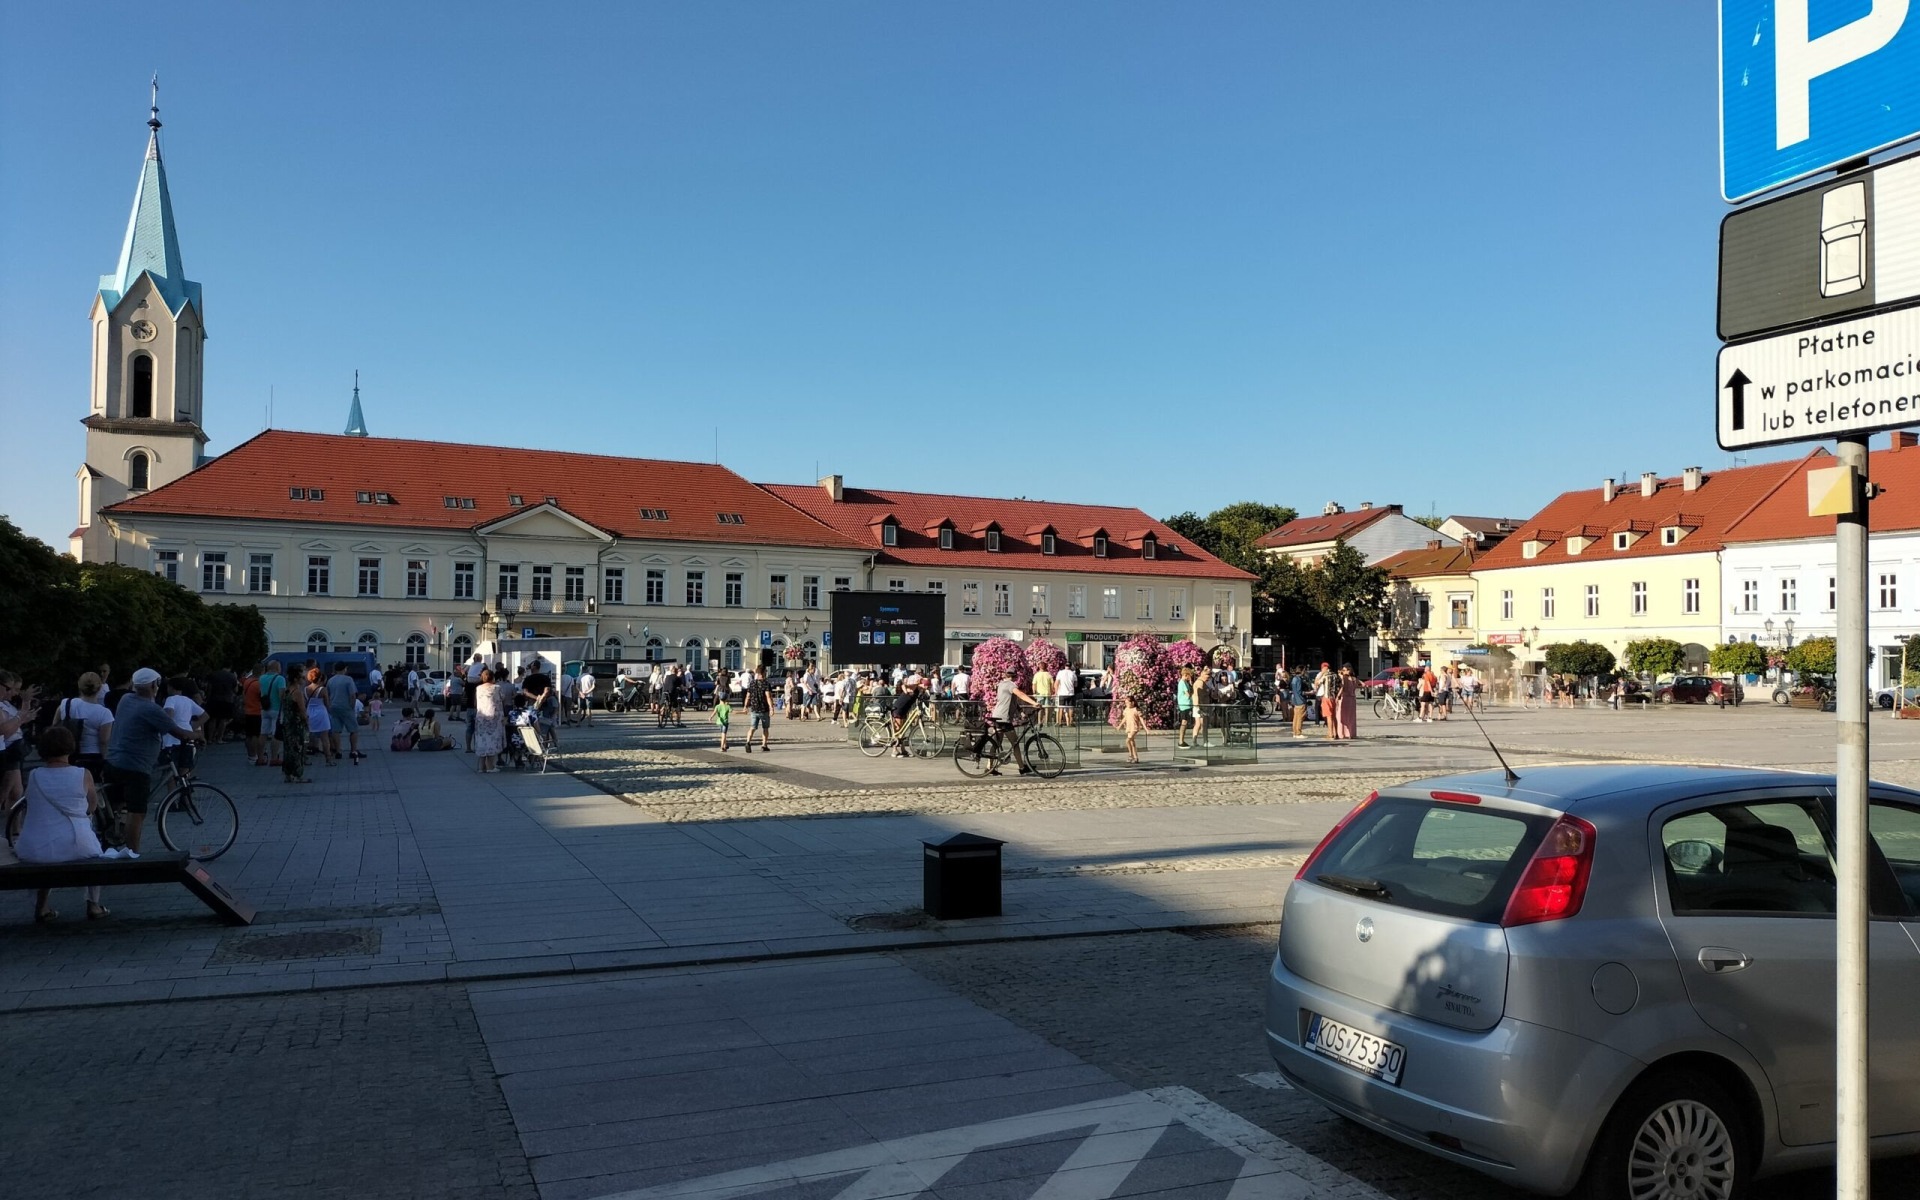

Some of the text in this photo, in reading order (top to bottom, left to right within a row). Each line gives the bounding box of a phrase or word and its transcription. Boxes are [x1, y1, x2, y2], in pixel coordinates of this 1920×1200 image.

[1798, 330, 1876, 358] Płatne
[1761, 385, 1776, 400] w
[1763, 409, 1795, 432] lub
[762, 631, 770, 641] P
[1348, 1032, 1402, 1073] 75350
